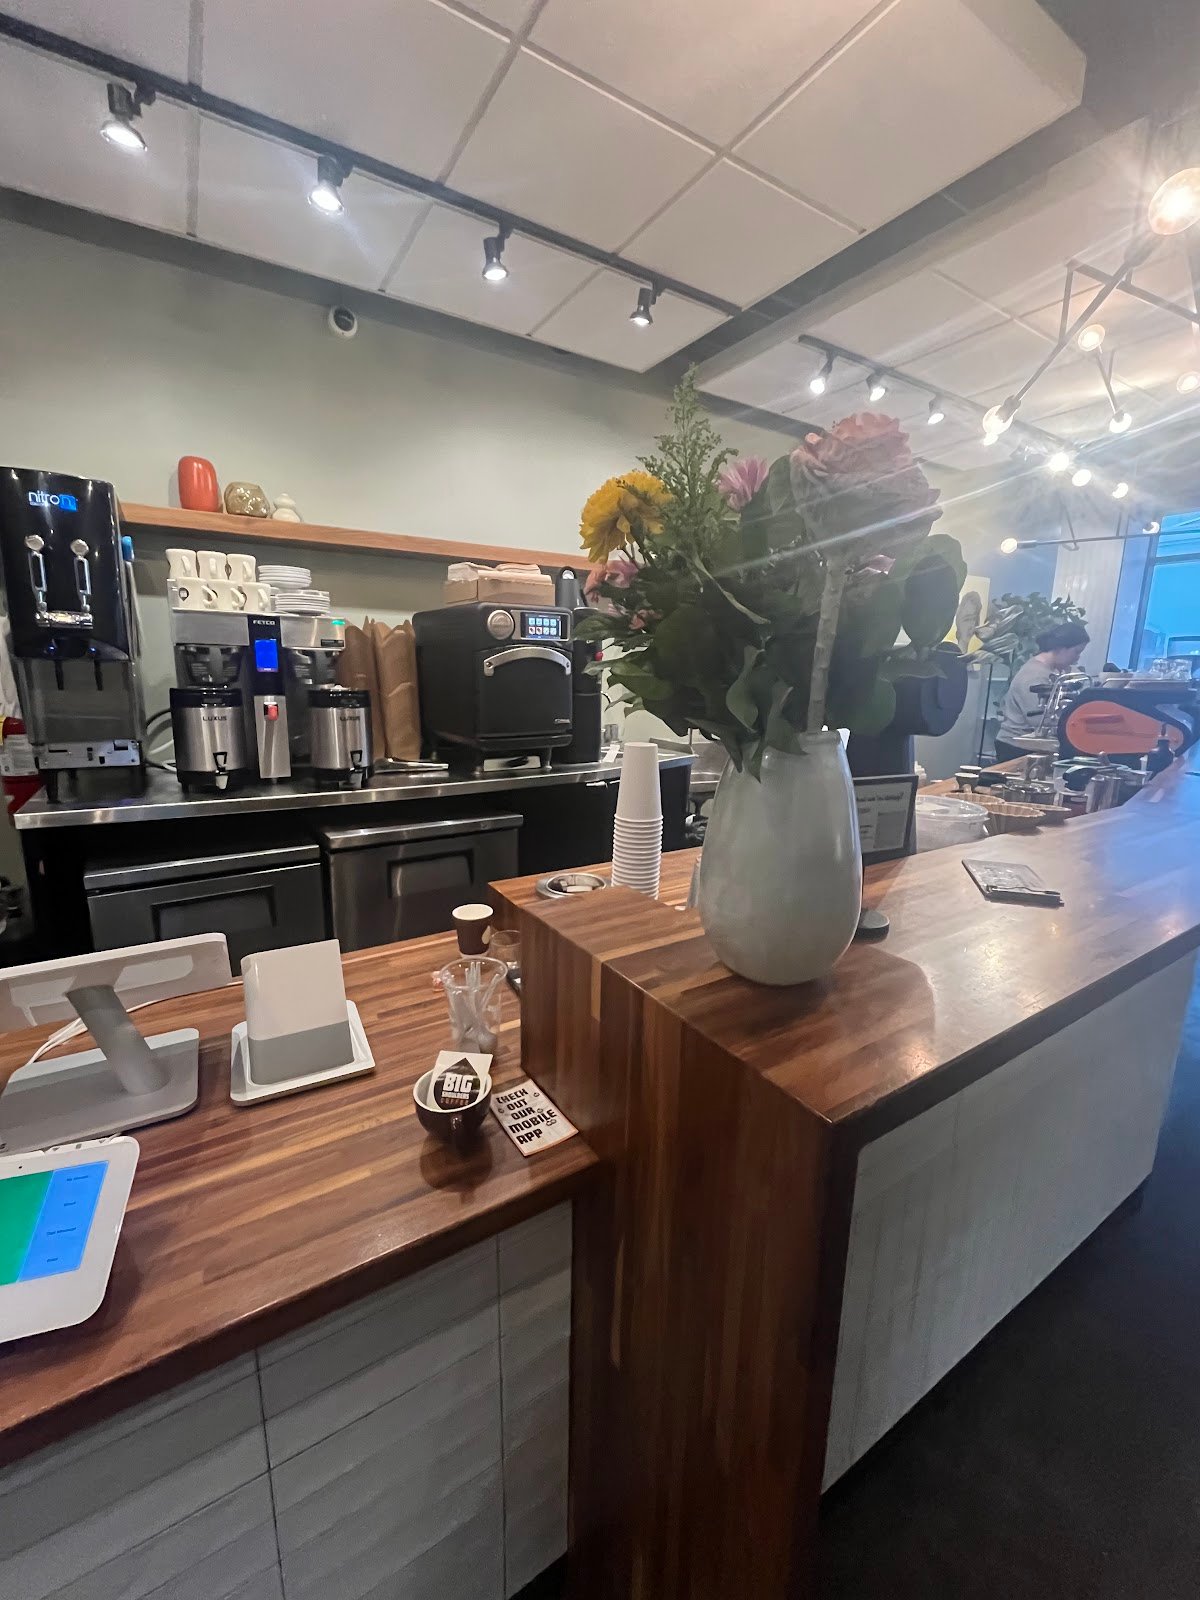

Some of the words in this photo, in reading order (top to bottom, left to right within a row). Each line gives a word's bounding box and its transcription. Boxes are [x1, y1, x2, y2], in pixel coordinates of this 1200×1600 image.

[442, 1072, 474, 1093] BIG
[495, 1088, 529, 1104] CHECK
[506, 1098, 528, 1111] OUT
[510, 1106, 536, 1120] OUR
[508, 1109, 557, 1134] MOBILE
[516, 1128, 543, 1145] APP
